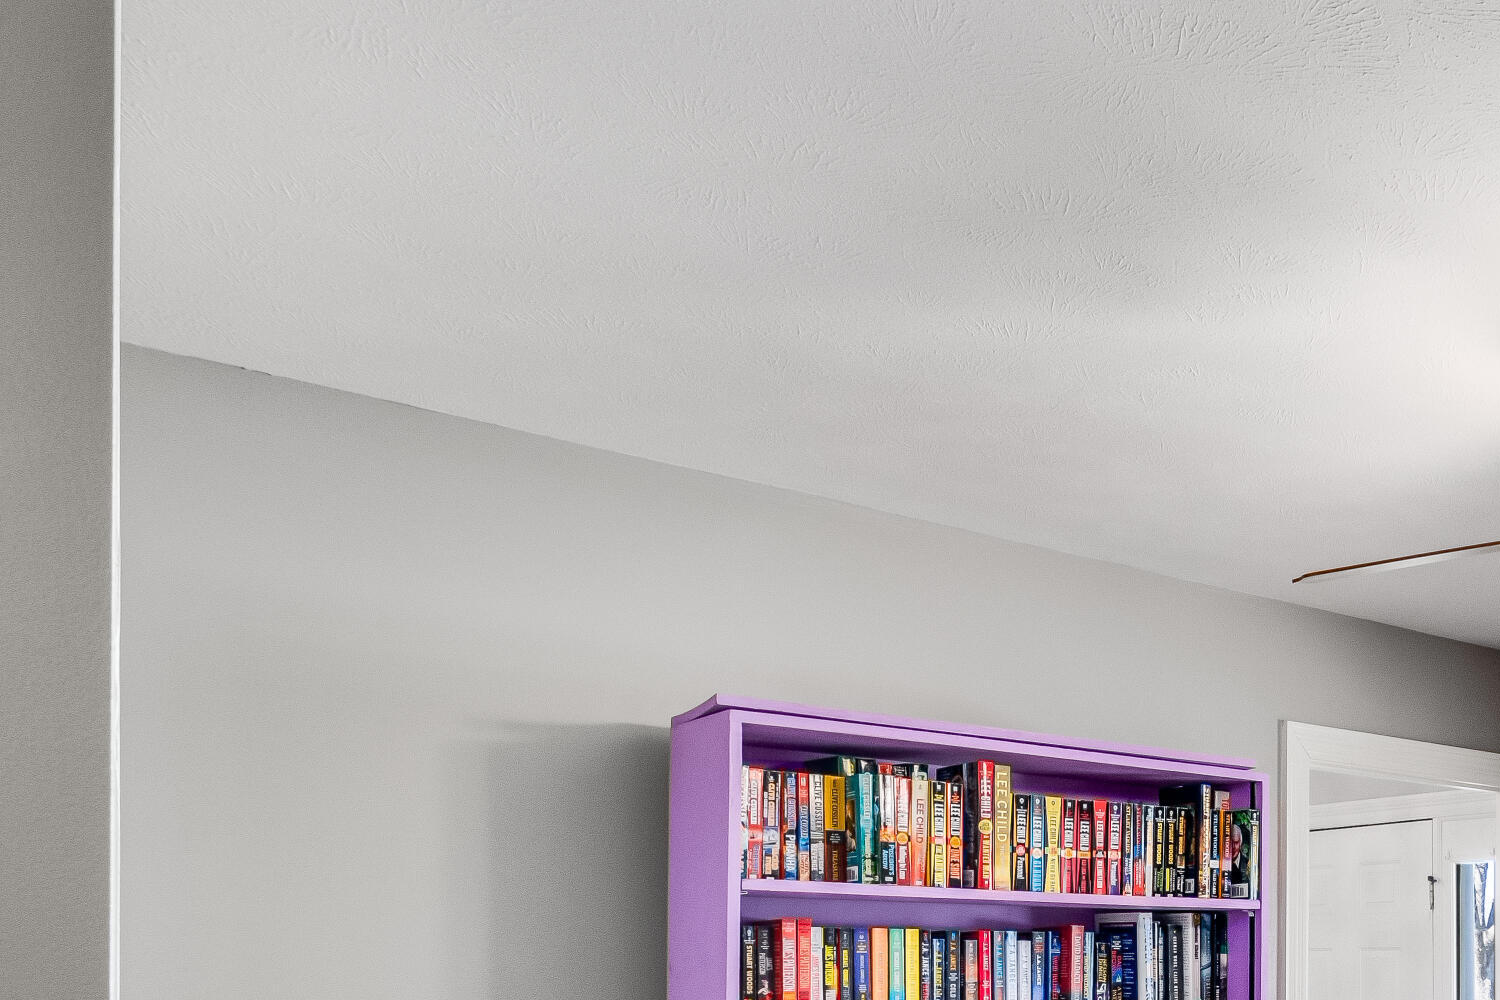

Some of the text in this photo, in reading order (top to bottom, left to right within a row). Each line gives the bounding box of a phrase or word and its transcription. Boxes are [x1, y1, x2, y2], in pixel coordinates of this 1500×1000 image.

[814, 781, 823, 831] CLIVE CUSSLER
[981, 779, 991, 818] LEE CHILD
[997, 772, 1007, 842] LEE CHILD
[916, 798, 924, 844] LEE CHILD
[934, 803, 944, 837] LEE CHILD
[950, 804, 960, 836] LEE CHILD
[1017, 814, 1026, 843] LEE CHILD
[1033, 816, 1042, 847] LEE CHILD
[1065, 818, 1074, 848] LEE CHILD
[1111, 821, 1119, 850] LEE CHILD
[982, 839, 991, 863] WANTED
[1080, 821, 1090, 851] LEE CHILD
[786, 834, 796, 871] PIRANHA
[950, 848, 960, 880] ONE SHOT
[1017, 857, 1025, 880] Personal
[1110, 861, 1118, 886] Persuader
[800, 935, 810, 956] JAMES
[783, 938, 794, 992] JAMES PATTERSON
[800, 956, 810, 989] PATTERSON
[825, 945, 834, 986] JAMES PATTERSON
[922, 956, 930, 976] JANCE
[746, 970, 754, 995] WOODS
